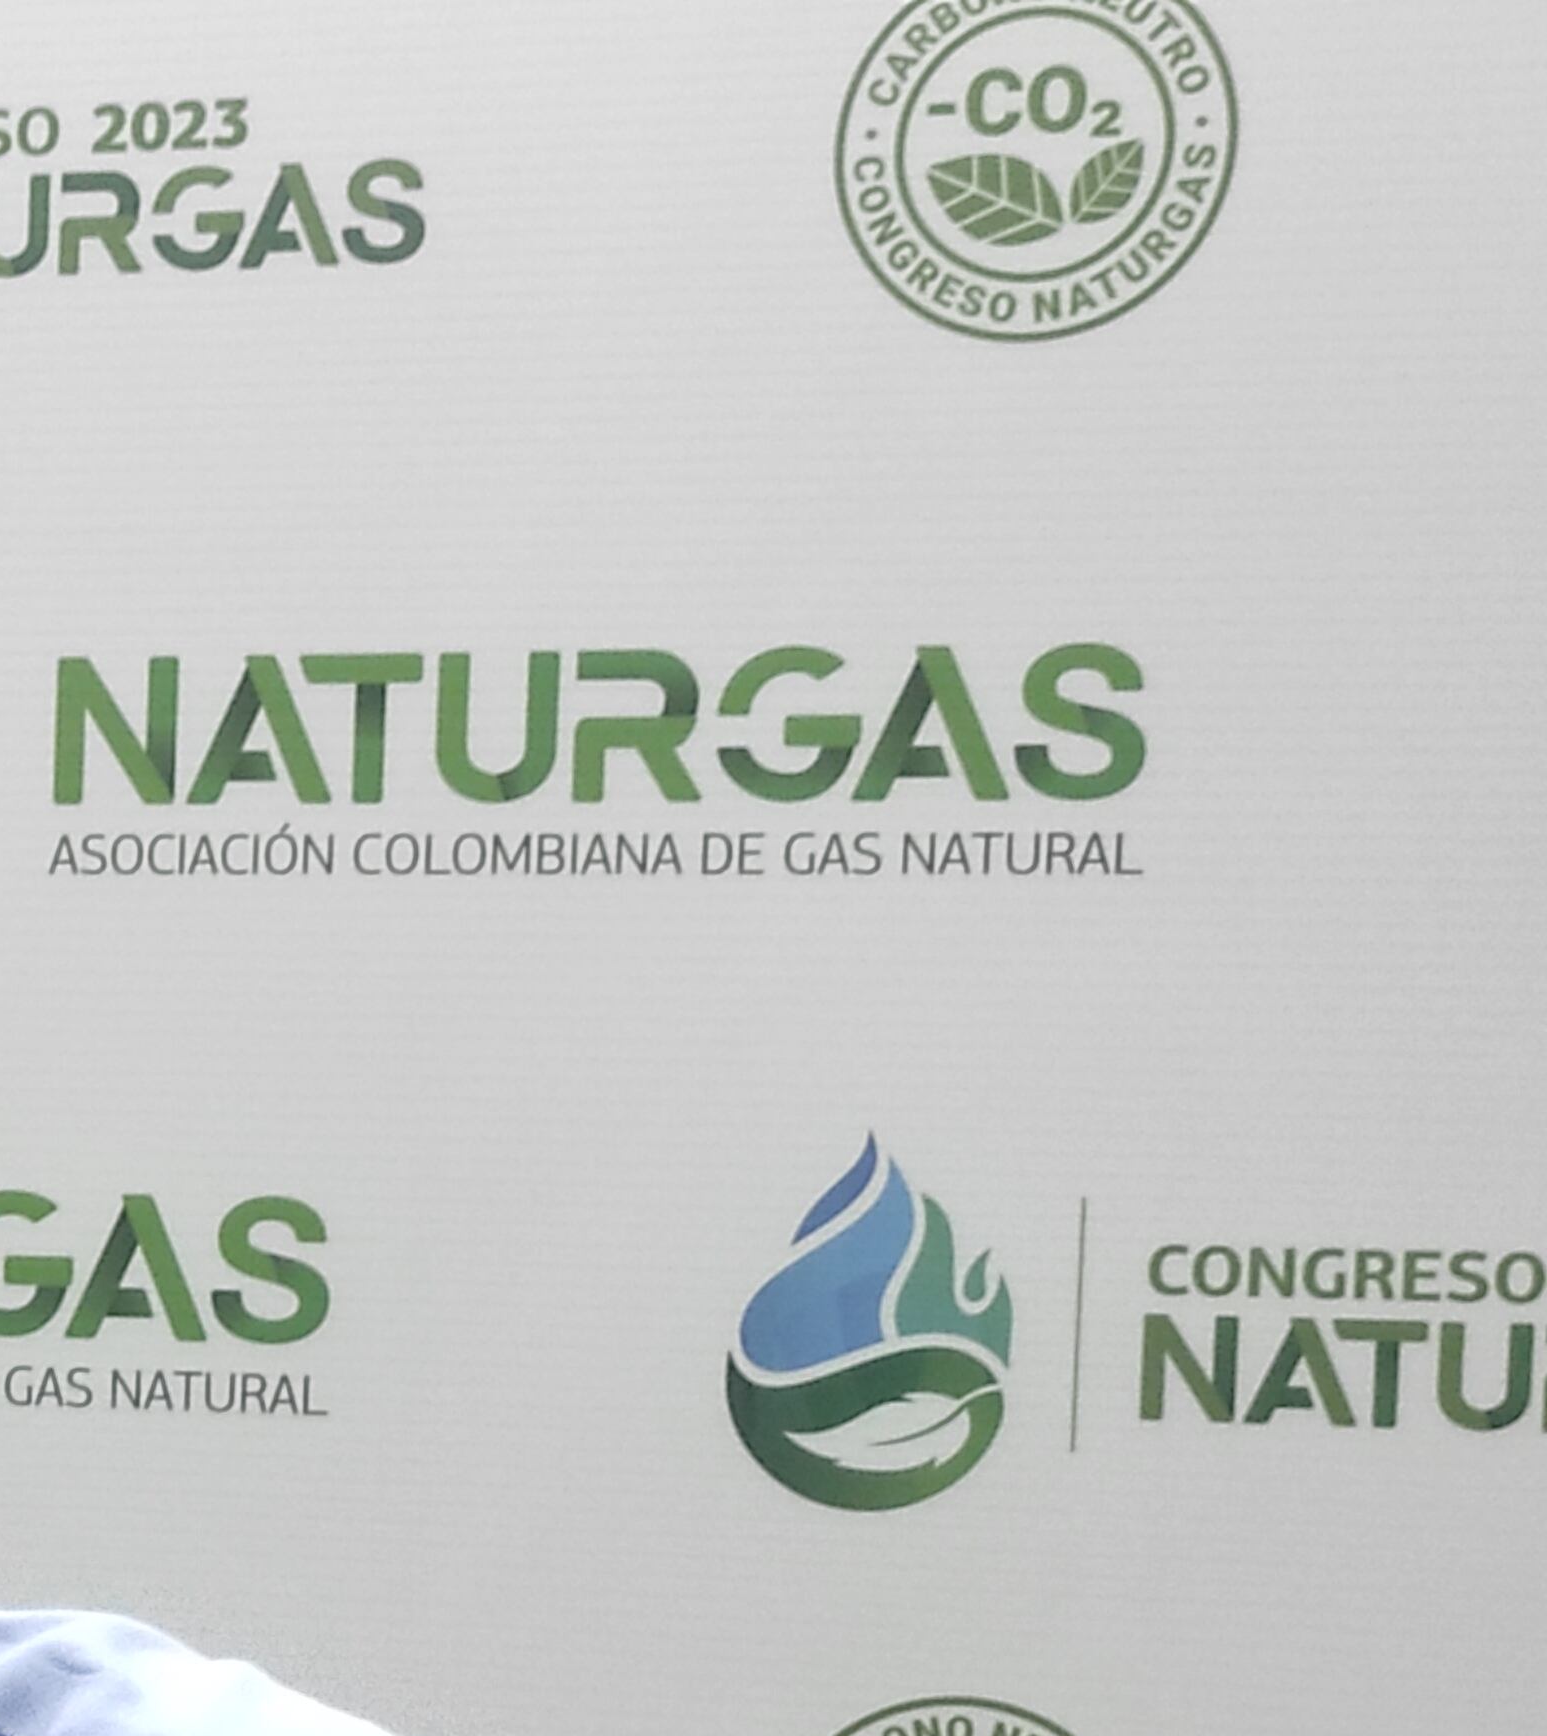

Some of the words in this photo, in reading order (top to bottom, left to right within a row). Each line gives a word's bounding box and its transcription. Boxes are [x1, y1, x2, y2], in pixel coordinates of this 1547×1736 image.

[93, 97, 248, 154] 2023
[853, 155, 1017, 324] CONGRESO
[1032, 142, 1217, 324] NATURGAS
[52, 643, 1147, 805] NATURGAS
[48, 822, 334, 877] ASOCIACIÓN
[353, 831, 683, 877] COLOMBIANA
[702, 832, 764, 876] DE
[784, 831, 881, 876] GAS
[902, 831, 1144, 876] NATURAL
[1148, 1243, 1545, 1304] CONGRESO
[5, 1364, 93, 1410] GAS
[110, 1369, 329, 1417] NATURAL
[1139, 1313, 1547, 1432] NATU
